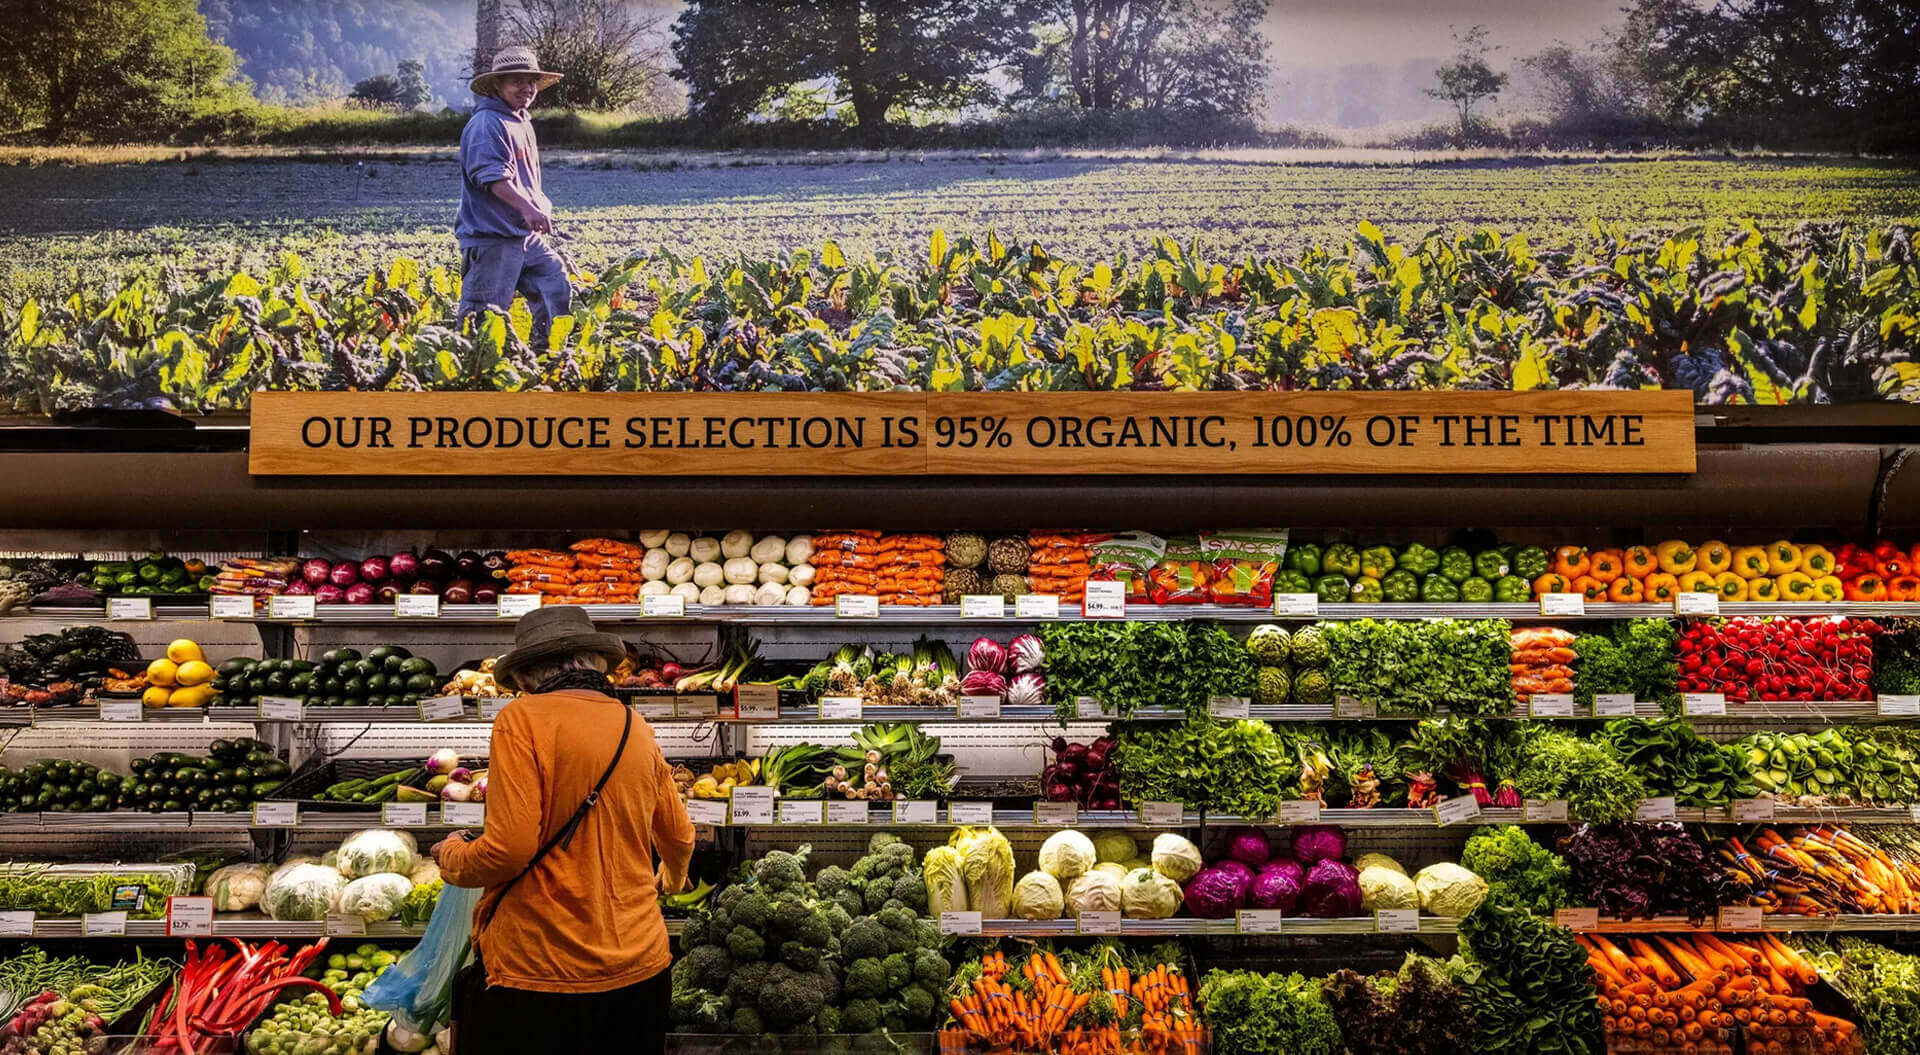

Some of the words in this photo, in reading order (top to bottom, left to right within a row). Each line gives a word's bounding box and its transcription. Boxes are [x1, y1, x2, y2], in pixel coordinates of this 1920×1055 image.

[302, 417, 394, 448] OUR
[408, 417, 610, 448] PRODUCE
[625, 417, 864, 448] SELECTION
[881, 417, 919, 448] IS
[934, 416, 1013, 448] 95%
[1026, 415, 1238, 451] ORGANIC,
[1252, 415, 1352, 447] 100%
[1366, 414, 1420, 446] OF
[1433, 414, 1522, 446] THE
[1534, 414, 1644, 446] TIME
